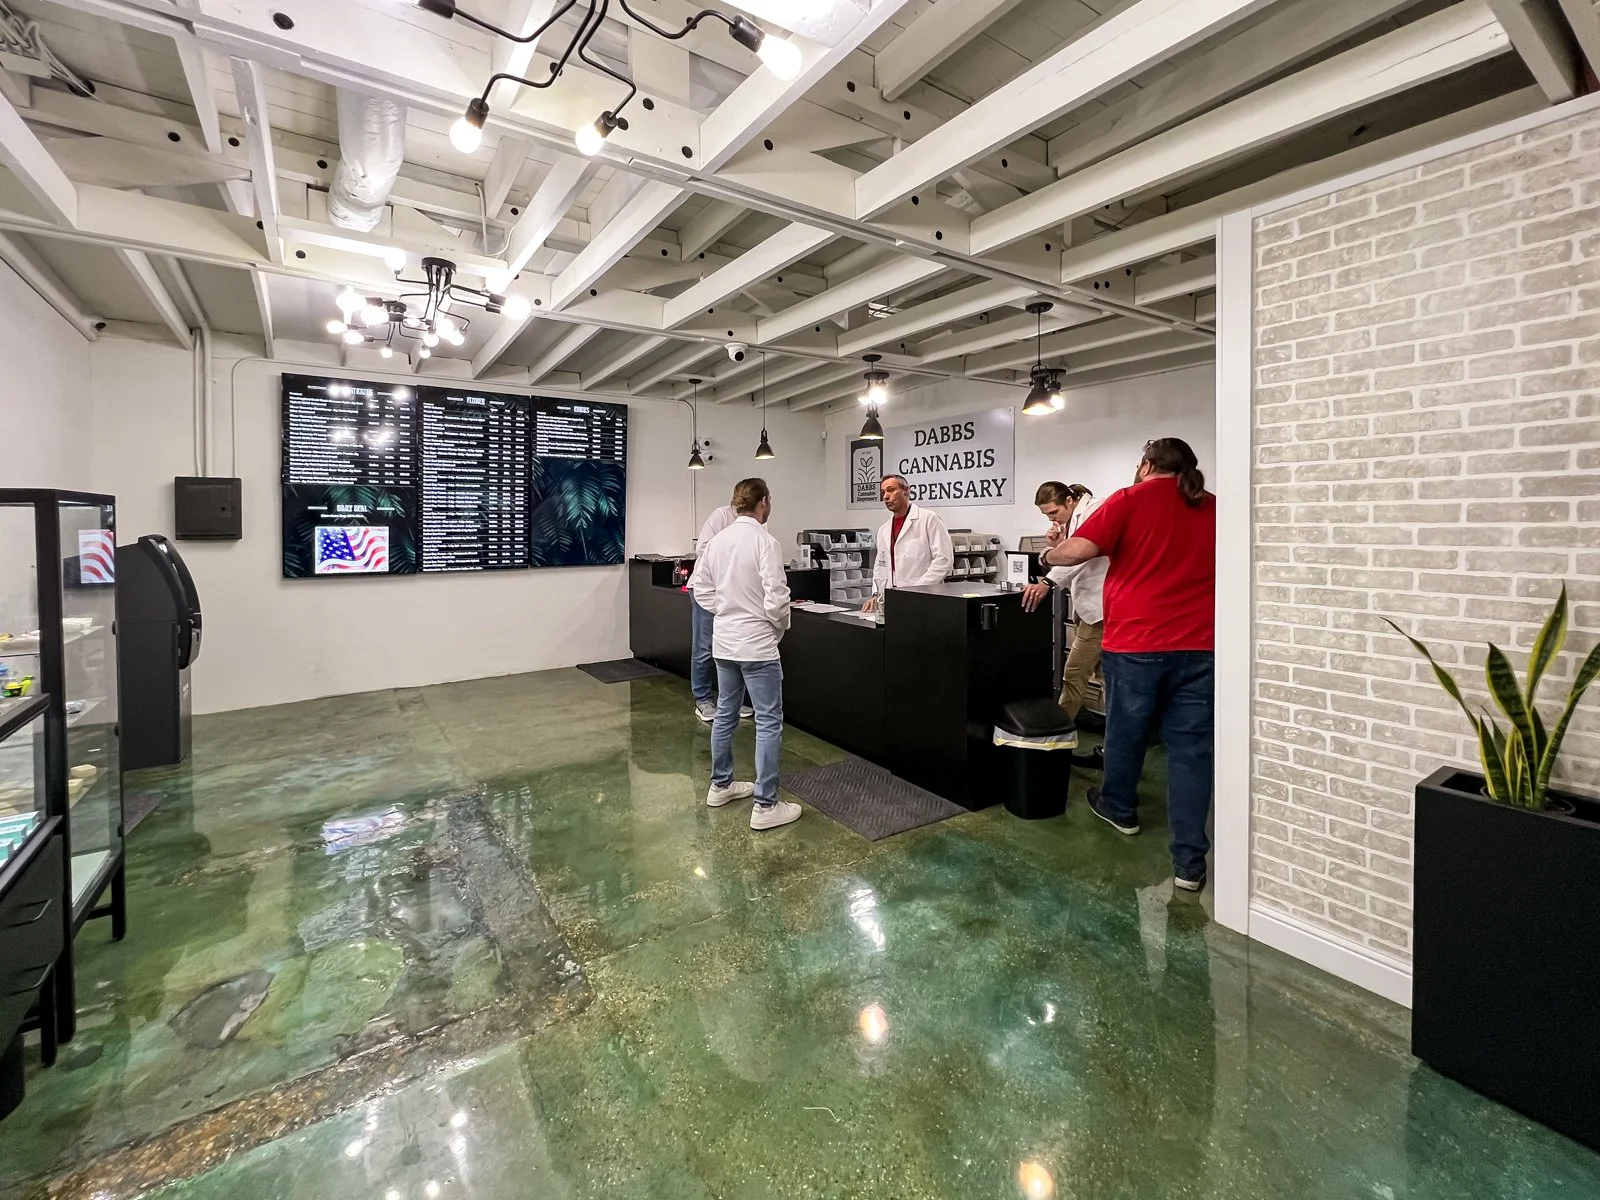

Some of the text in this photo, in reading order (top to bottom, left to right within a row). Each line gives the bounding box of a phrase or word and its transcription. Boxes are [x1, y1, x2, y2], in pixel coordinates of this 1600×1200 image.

[914, 421, 975, 447] DABBS
[898, 448, 995, 475] CANNABIS
[857, 483, 876, 492] DABBS
[908, 477, 1007, 501] SPENSARY
